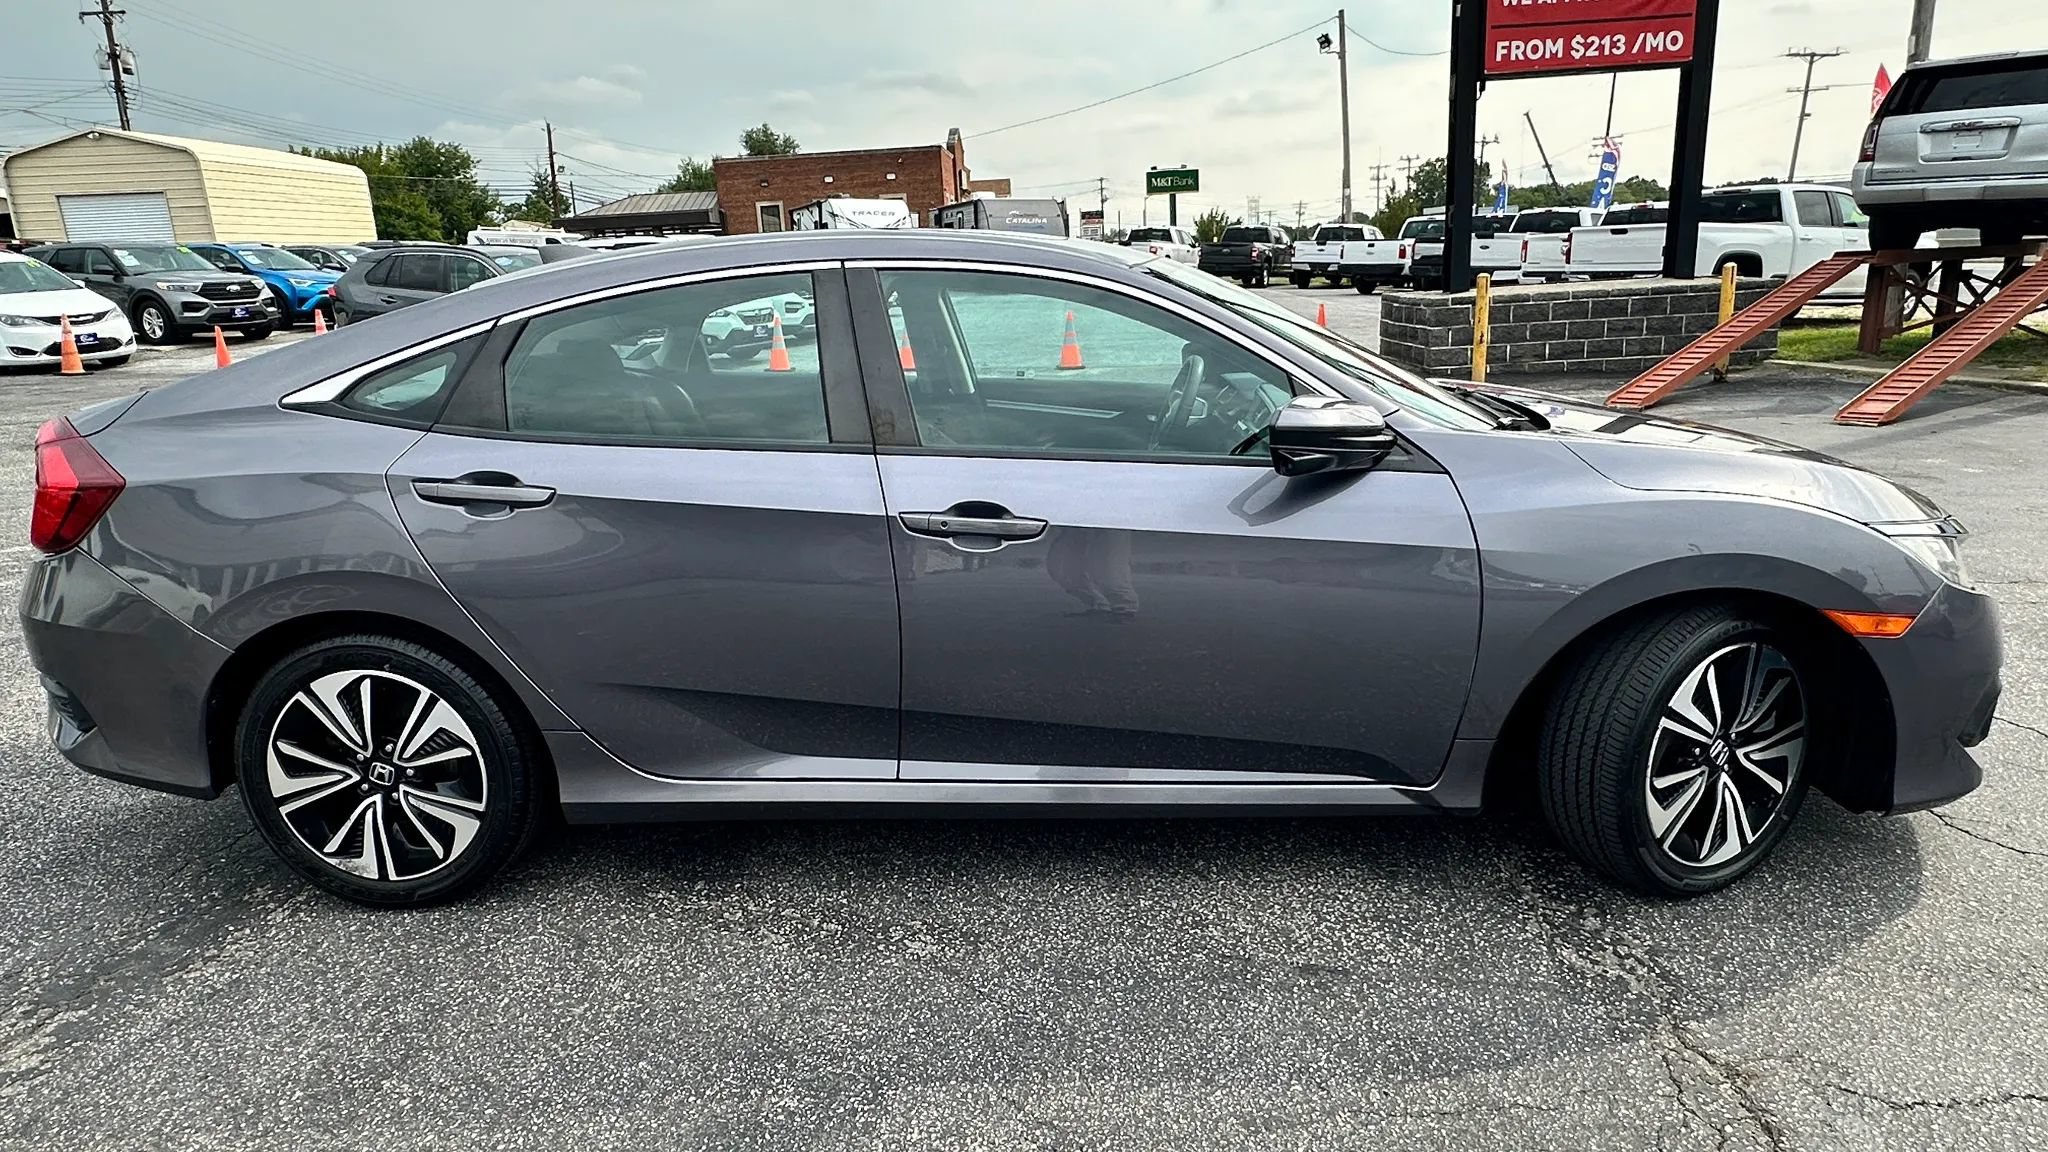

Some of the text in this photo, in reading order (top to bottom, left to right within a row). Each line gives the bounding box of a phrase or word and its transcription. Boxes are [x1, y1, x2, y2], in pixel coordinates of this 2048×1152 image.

[1495, 30, 1684, 62] FROM $213 /MO
[1951, 121, 1978, 130] GMC
[1151, 175, 1195, 188] M&T Bank
[851, 209, 896, 218] TRACER
[1005, 216, 1049, 225] CATALINA
